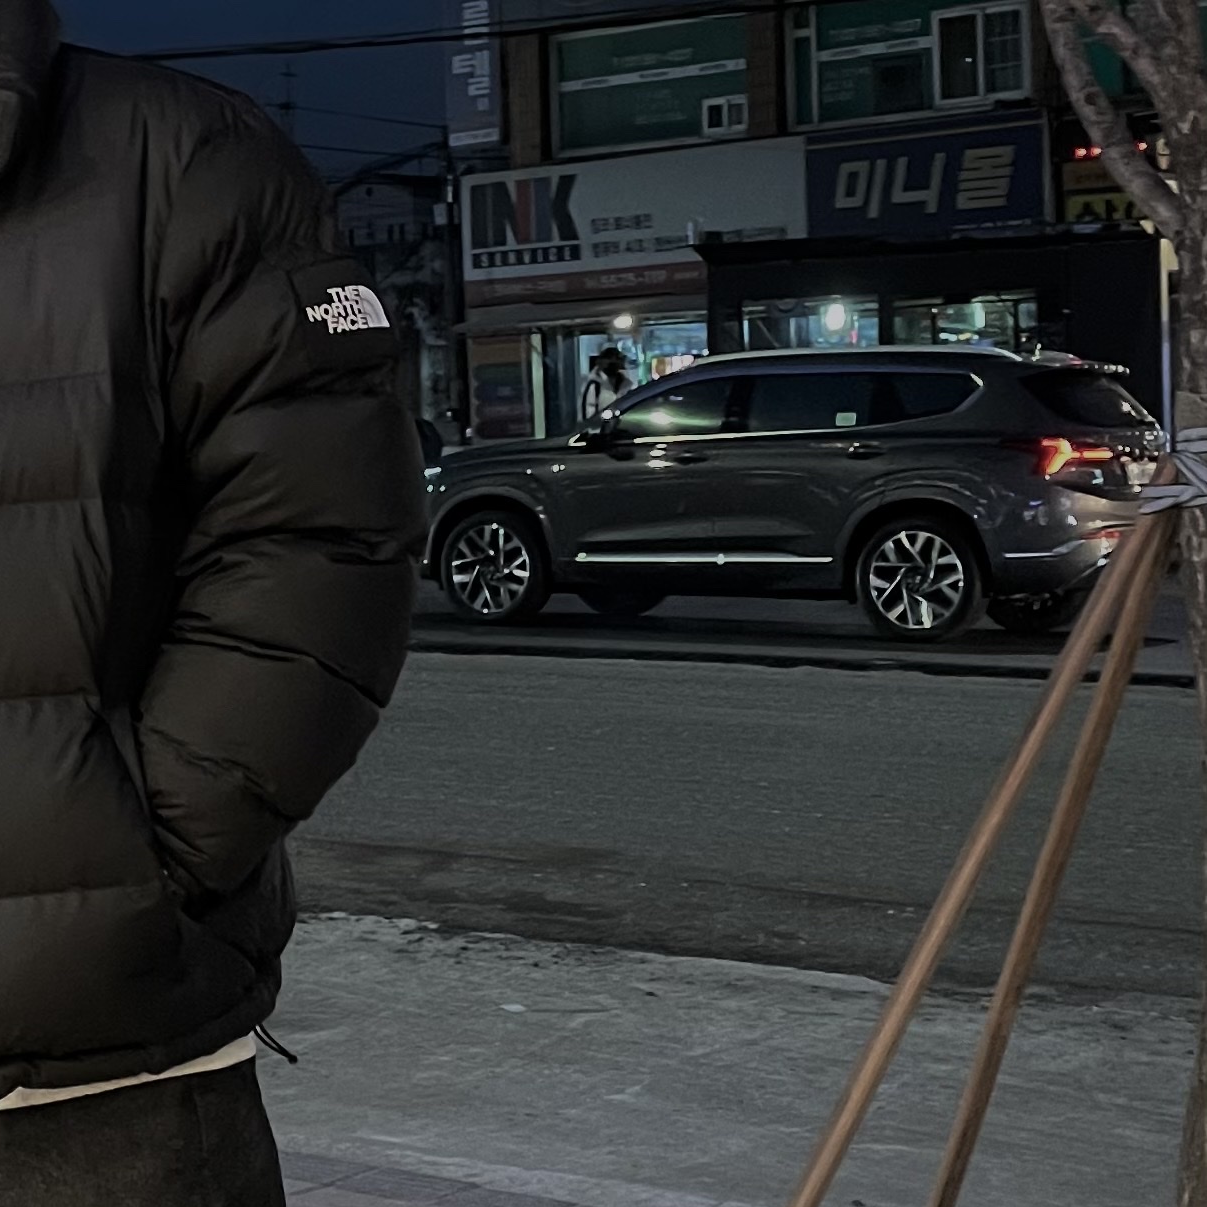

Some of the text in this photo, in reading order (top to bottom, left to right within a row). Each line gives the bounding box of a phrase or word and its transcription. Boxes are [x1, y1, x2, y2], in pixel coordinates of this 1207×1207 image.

[834, 145, 1017, 219] 미니몰
[470, 175, 581, 249] INK
[326, 284, 361, 304] THE
[305, 299, 364, 323] NORTH
[327, 313, 369, 334] FACE
